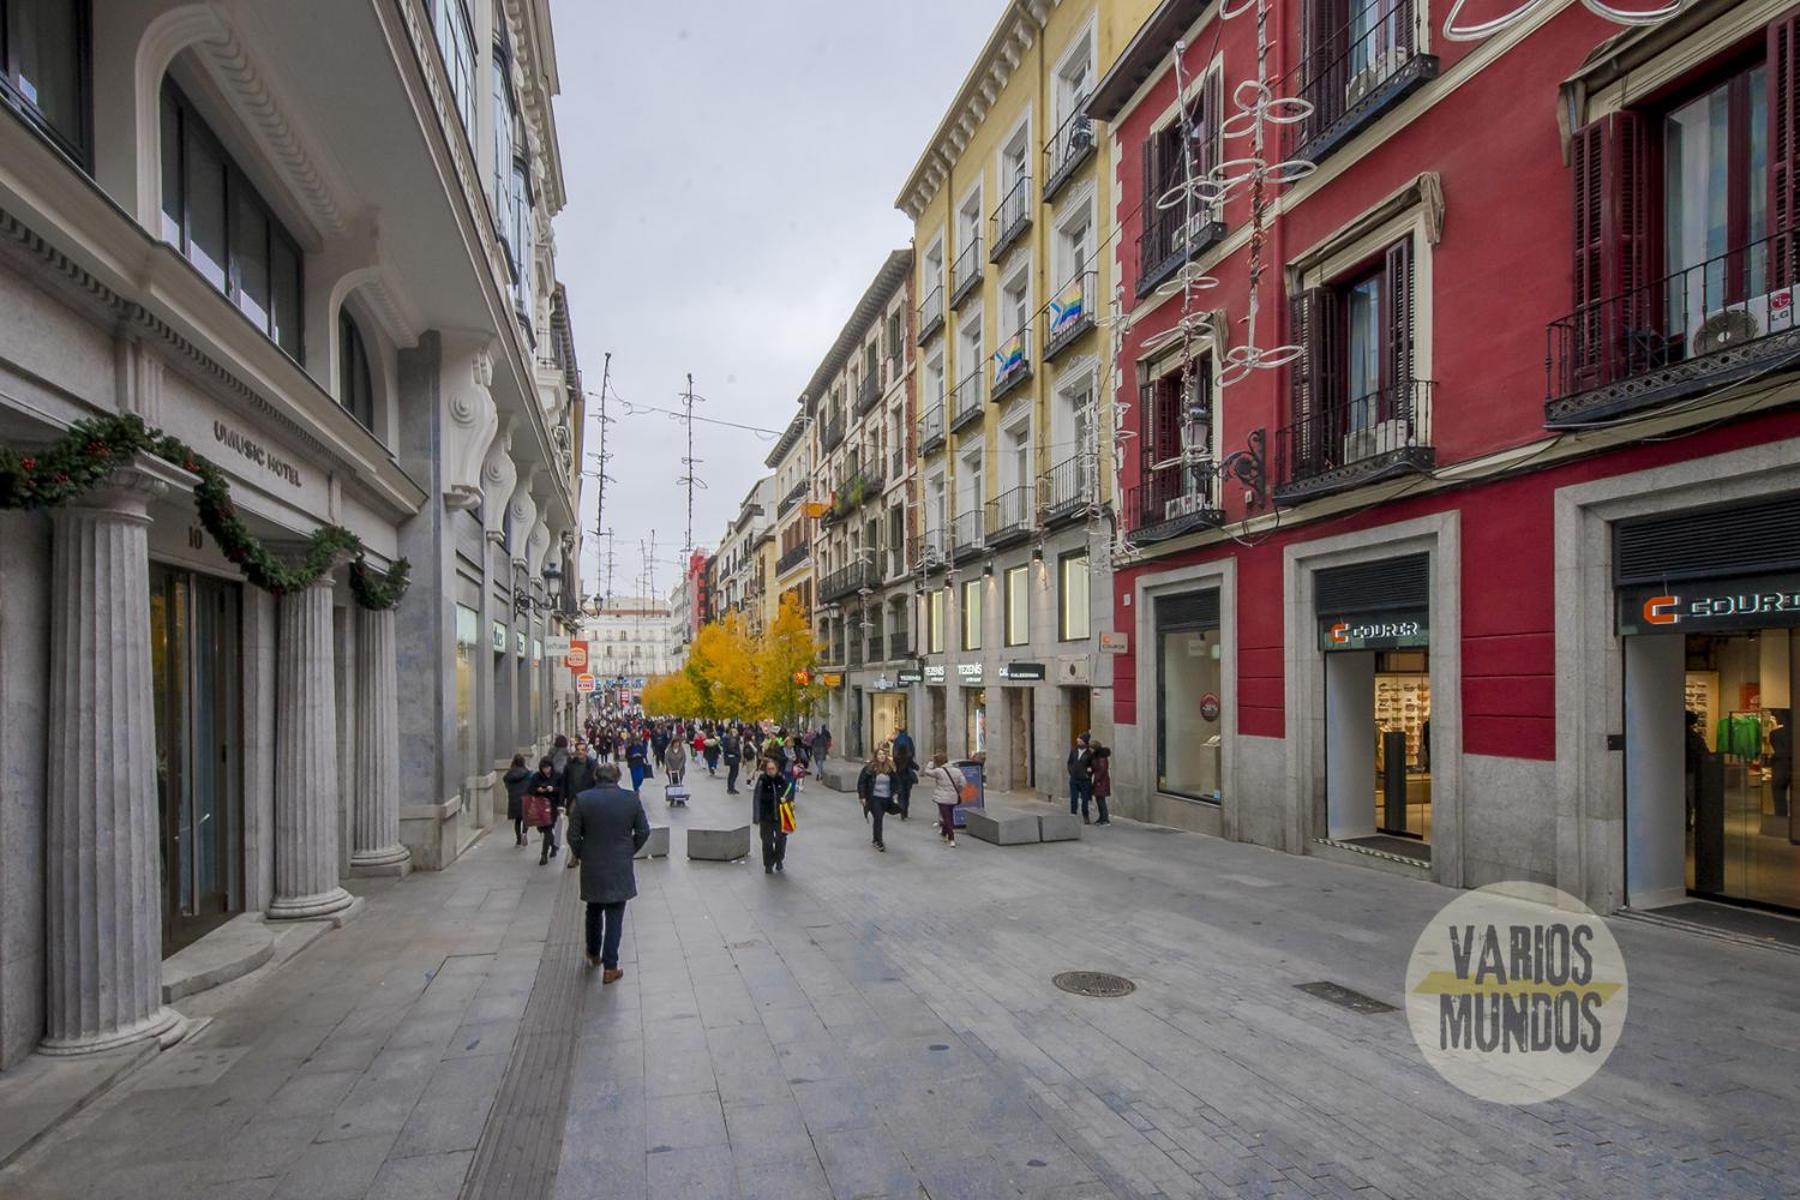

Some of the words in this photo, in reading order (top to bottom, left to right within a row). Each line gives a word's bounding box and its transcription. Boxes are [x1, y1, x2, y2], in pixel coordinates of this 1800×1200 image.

[213, 420, 265, 467] UMUSIC
[267, 453, 302, 488] HOTEL
[1352, 621, 1418, 639] COURIR
